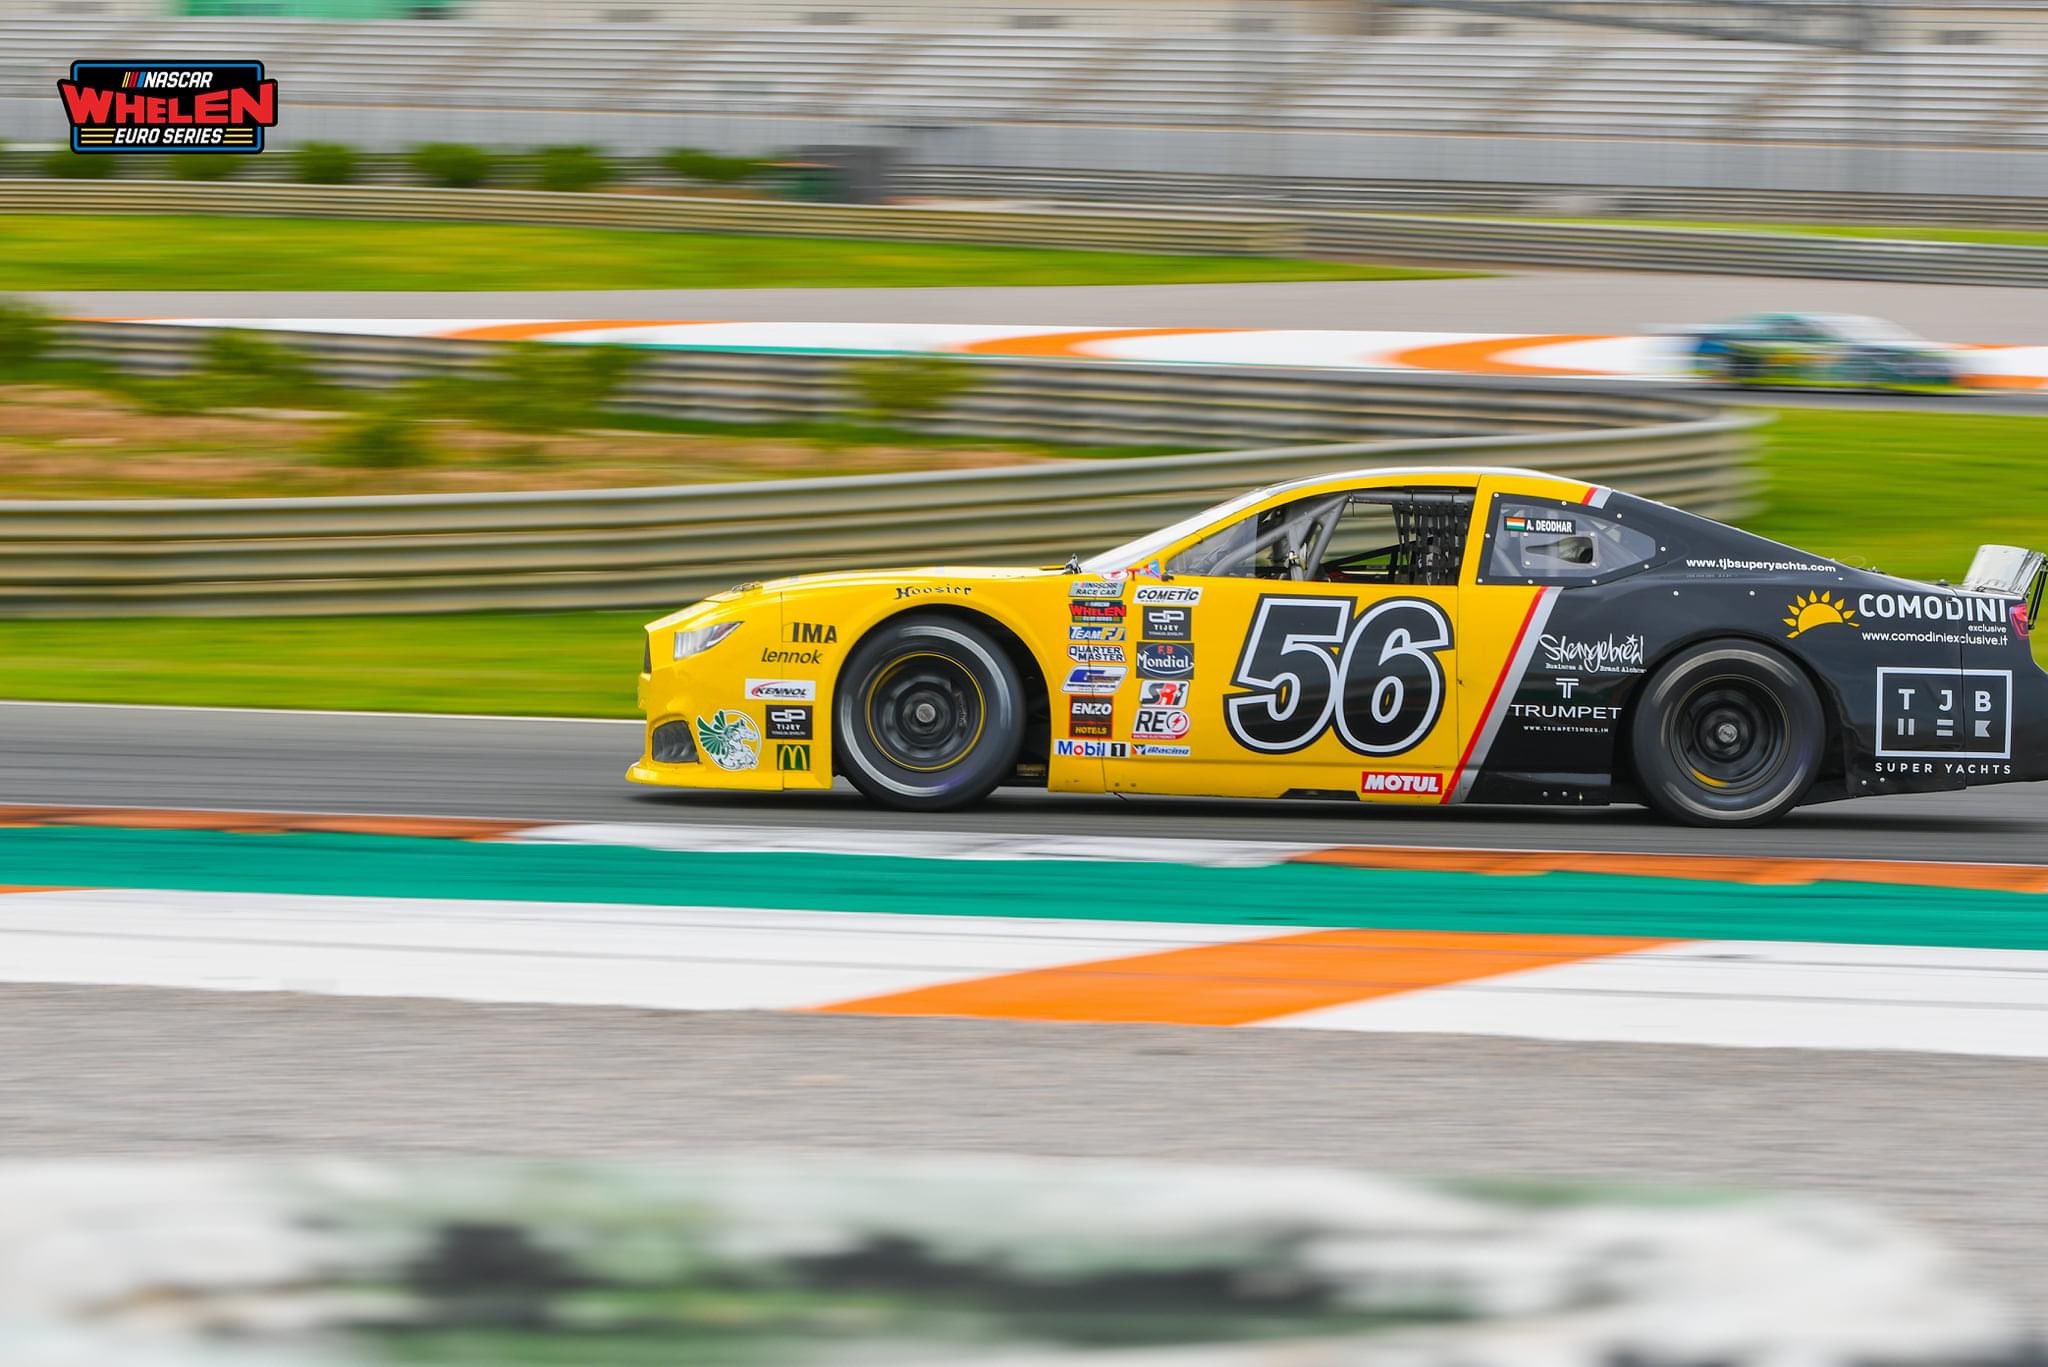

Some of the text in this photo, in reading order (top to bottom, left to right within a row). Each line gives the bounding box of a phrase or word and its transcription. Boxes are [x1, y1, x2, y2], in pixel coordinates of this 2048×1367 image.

[1526, 519, 1572, 533] A. DEODHAR
[1686, 558, 1836, 573] www.tjbsuperyachts.com
[895, 584, 972, 600] Hoosier
[1137, 588, 1199, 601] COMETIC
[1071, 605, 1125, 616] WHELEN
[1858, 593, 2007, 623] COMODINI
[792, 622, 838, 644] IMA
[1070, 627, 1102, 640] TEAM
[1968, 624, 2007, 633] exclusive
[1862, 630, 2009, 646] www.comodiniexclusive.it
[1069, 646, 1121, 656] QUARTER
[1078, 653, 1123, 661] MASTER
[1137, 651, 1195, 674] Mondial
[1223, 593, 1455, 757] 56
[756, 687, 807, 696] KENNOL
[1071, 702, 1112, 715] ENZO
[1510, 704, 1622, 719] TRUMPET
[1075, 727, 1107, 735] HOTELS
[1058, 741, 1105, 756] Mobil
[1875, 762, 2012, 775] SUPER YACHTS
[1364, 774, 1438, 792] MOTUL
